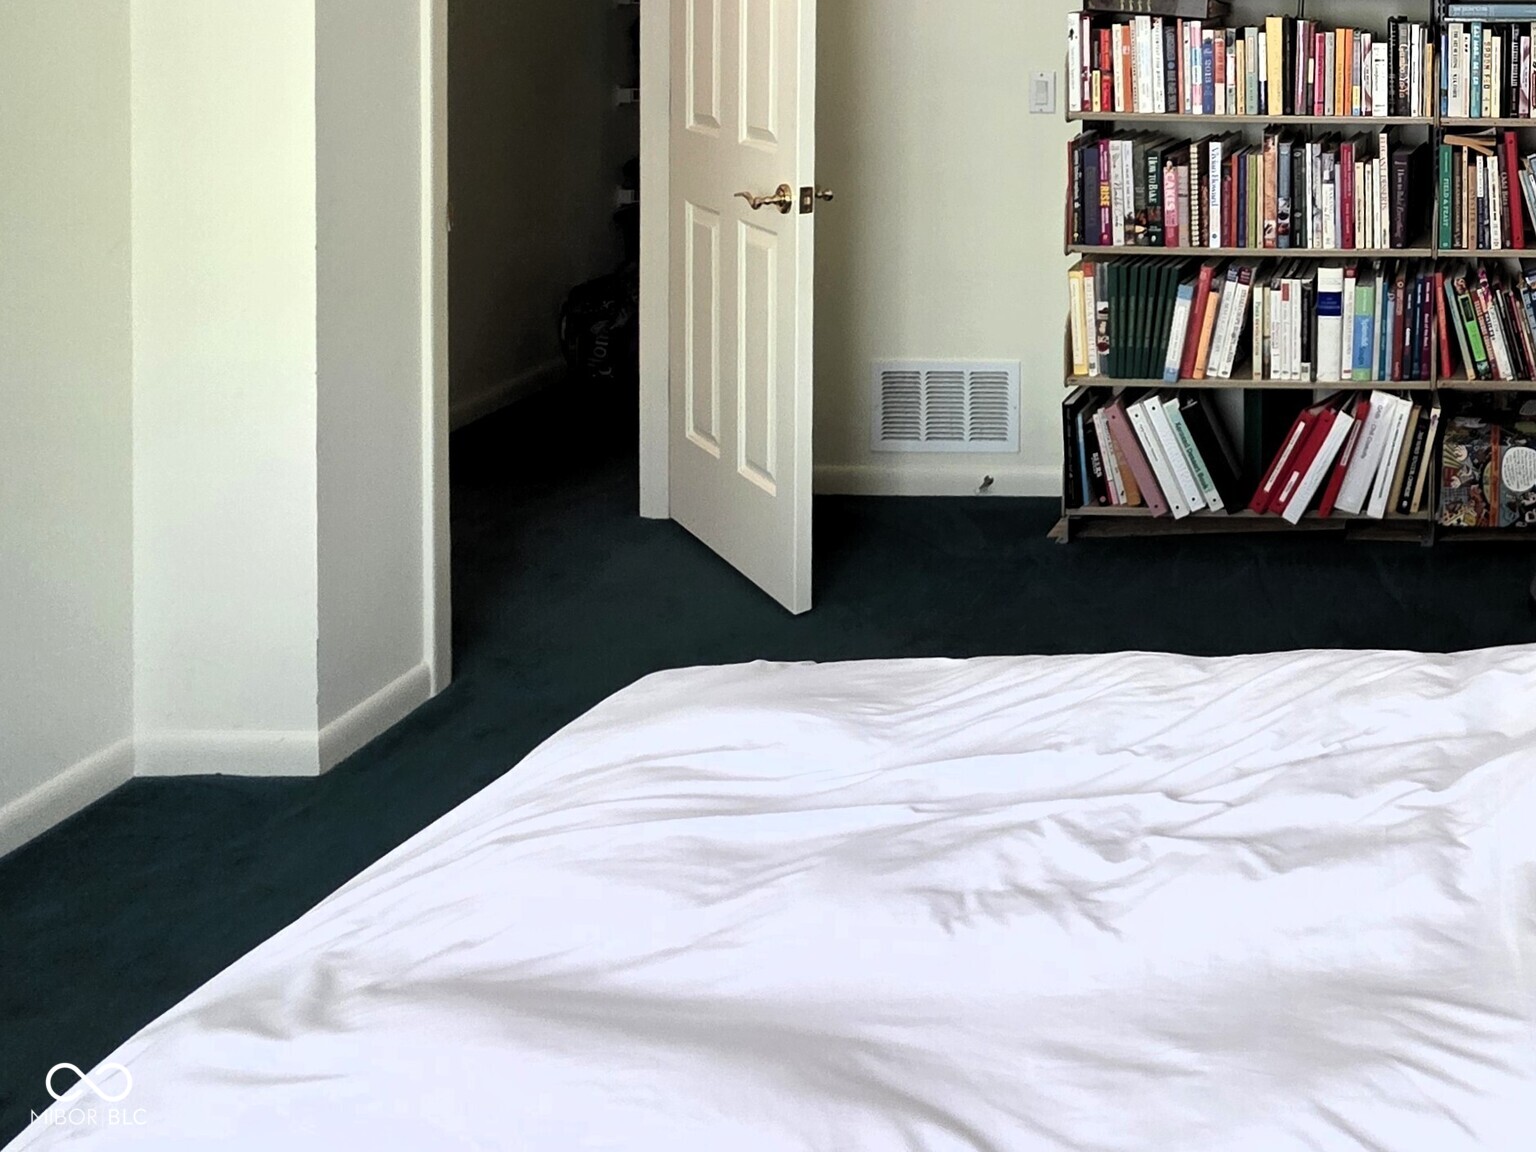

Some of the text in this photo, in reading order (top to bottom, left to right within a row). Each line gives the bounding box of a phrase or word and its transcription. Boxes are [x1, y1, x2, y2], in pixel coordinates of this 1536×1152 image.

[1100, 185, 1110, 206] RISE
[1148, 156, 1157, 203] HOW TO BAKE
[1165, 172, 1176, 210] CAKES
[1211, 147, 1219, 207] Vivian Howard
[1361, 318, 1370, 347] Splendid
[1186, 449, 1208, 490] Dessert Book
